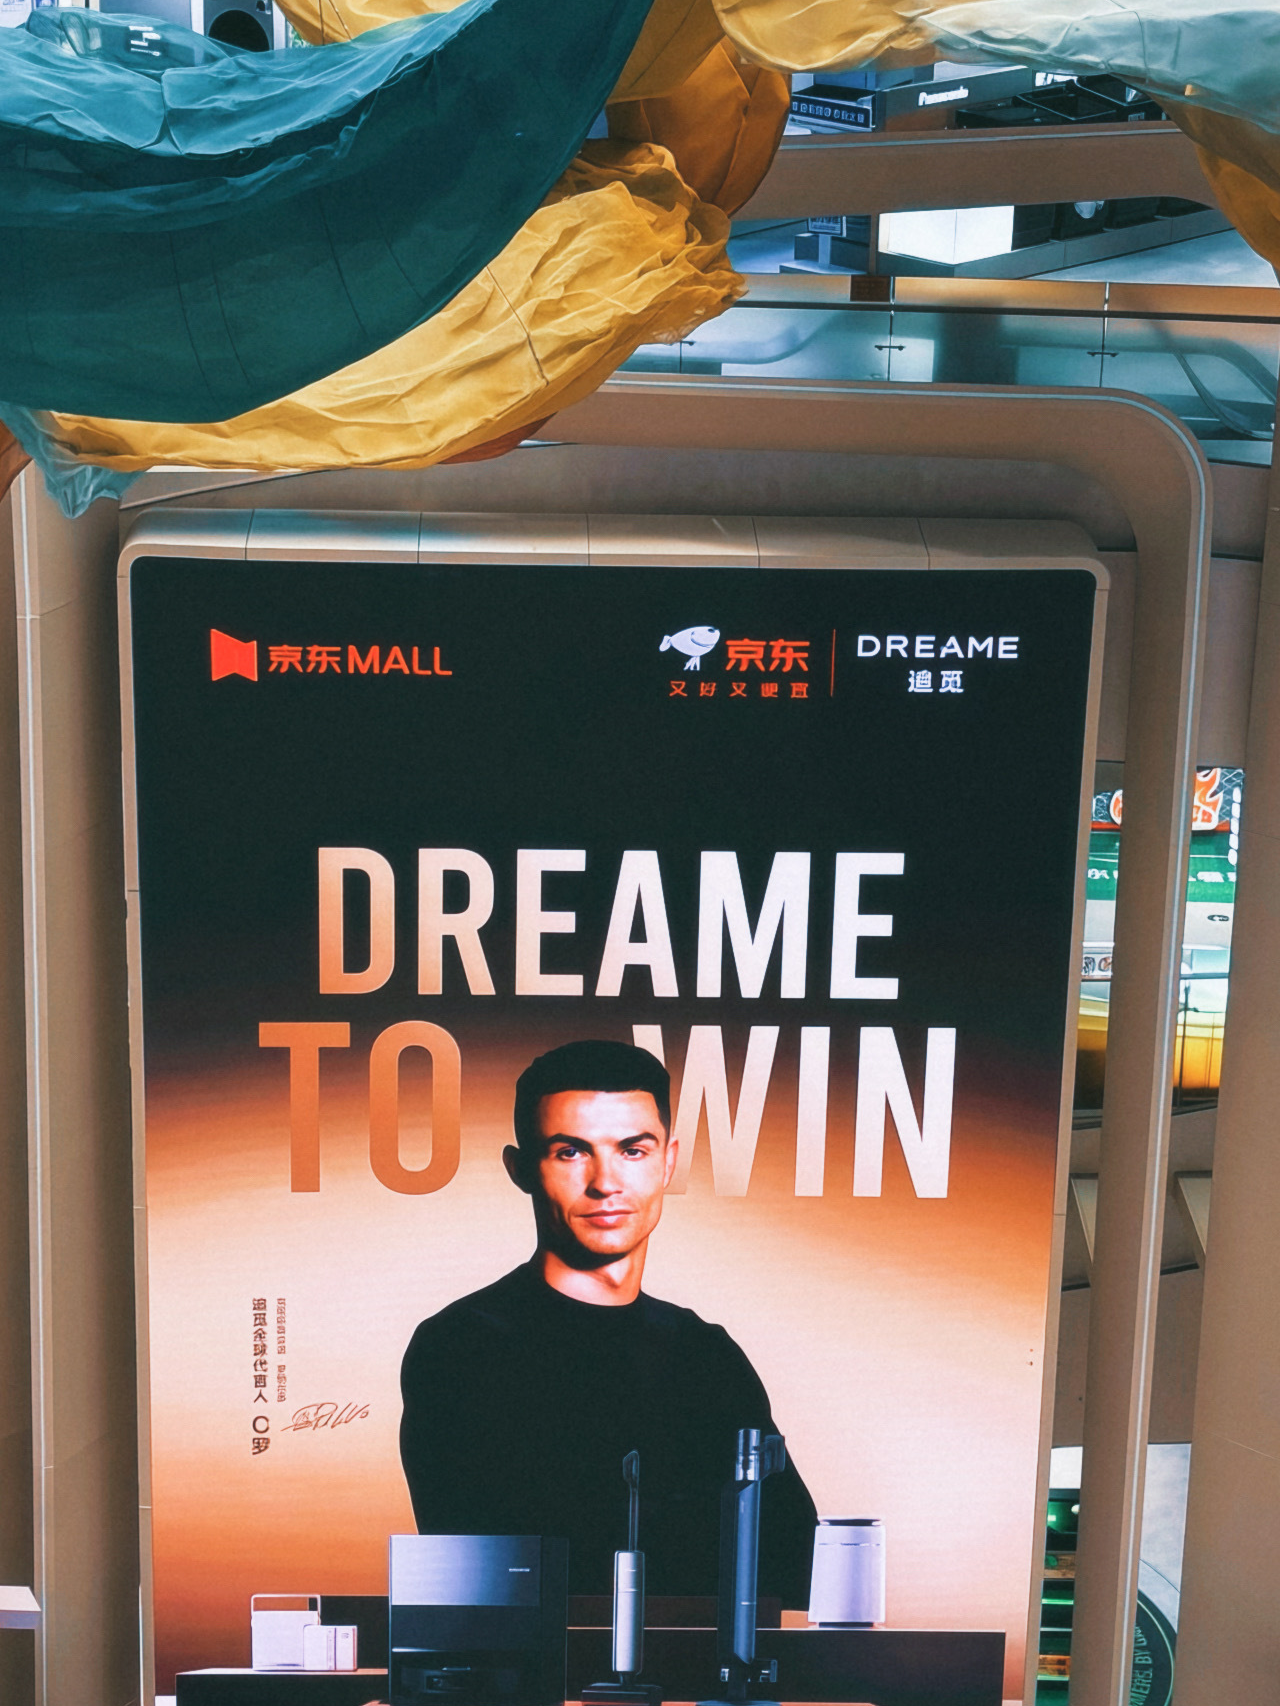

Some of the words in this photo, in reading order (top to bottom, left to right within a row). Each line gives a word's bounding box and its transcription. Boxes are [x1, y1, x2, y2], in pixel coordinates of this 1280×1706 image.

[267, 643, 453, 677] 京东MALL
[725, 637, 811, 672] 京东
[856, 634, 1020, 659] DREAME
[668, 680, 810, 700] 又好又便宜
[317, 846, 906, 1000] DREAME
[257, 1020, 463, 1197] TO
[632, 1023, 958, 1200] WIN
